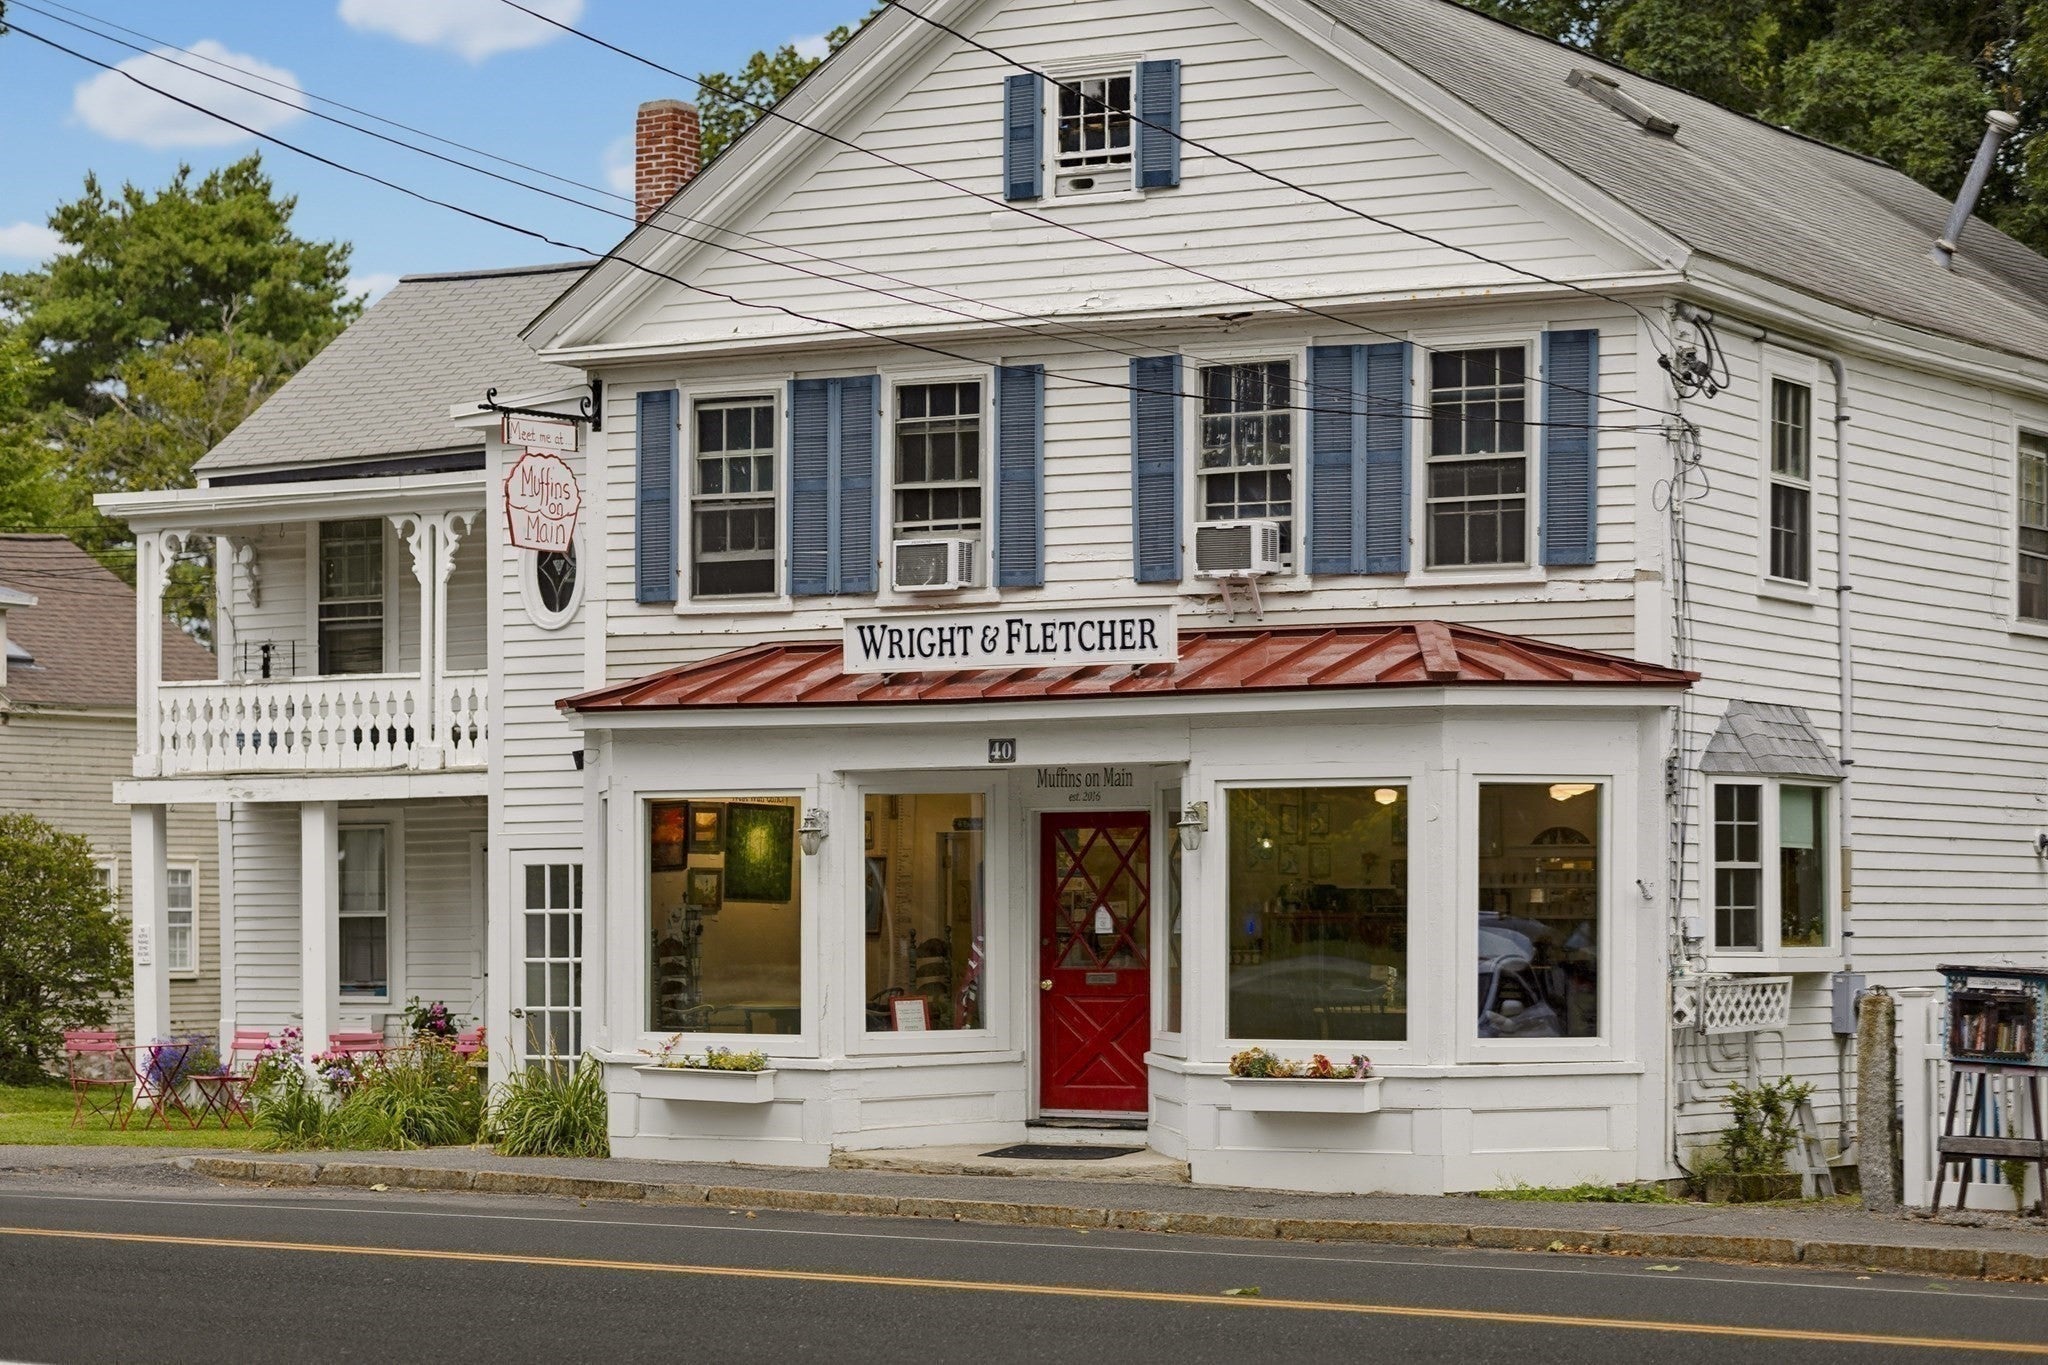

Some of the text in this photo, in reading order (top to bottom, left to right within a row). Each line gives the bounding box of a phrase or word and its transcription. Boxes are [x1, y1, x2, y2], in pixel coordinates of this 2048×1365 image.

[510, 421, 536, 442] Meet
[539, 433, 551, 444] me
[521, 465, 570, 506] Muffins
[549, 502, 564, 516] on
[525, 515, 566, 545] Main
[857, 618, 1158, 660] WRIGHT & FLETCHER
[990, 741, 1012, 760] 40
[1036, 767, 1133, 788] Muffins on Main
[1068, 791, 1101, 802] est. 2016
